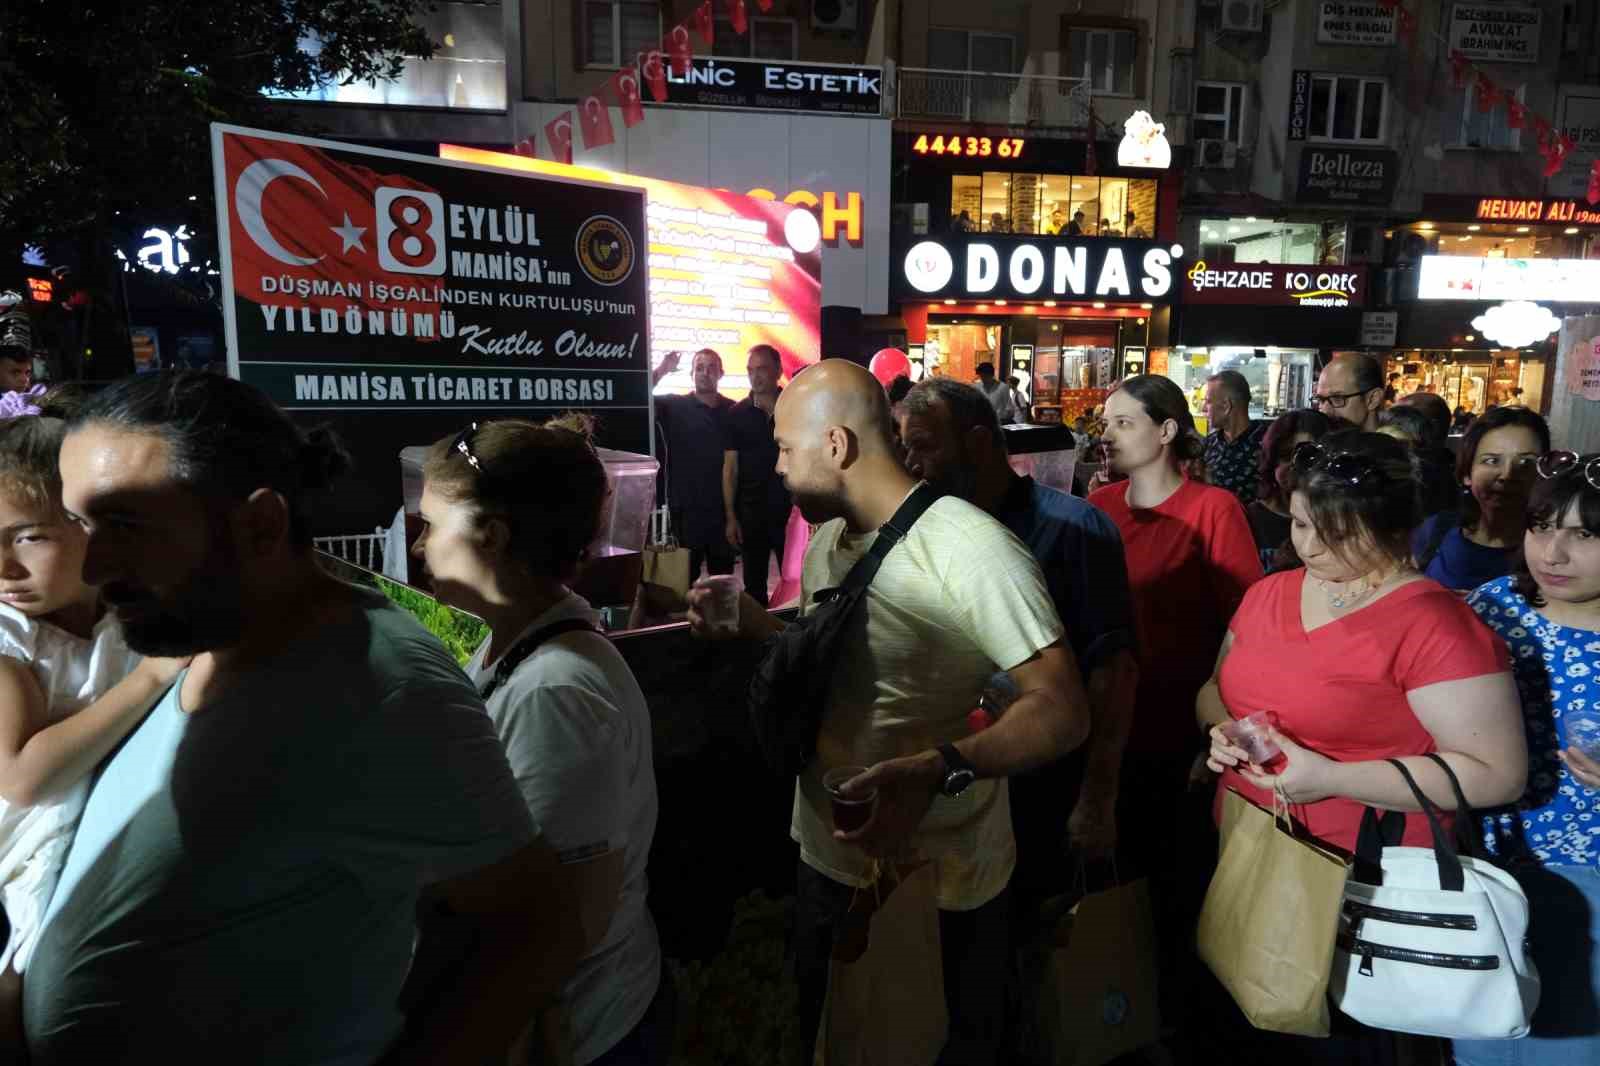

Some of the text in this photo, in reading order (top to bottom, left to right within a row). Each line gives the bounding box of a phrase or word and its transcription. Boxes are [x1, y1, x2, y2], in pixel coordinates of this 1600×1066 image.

[660, 60, 881, 95] LİNİC ESTETİK
[913, 134, 1025, 158] 444 33 67
[1310, 151, 1385, 178] Belleza
[1478, 199, 1543, 219] HELVACI
[387, 195, 541, 266] 8 EYLÜL
[966, 243, 1172, 297] DONAS
[1192, 270, 1358, 294] ŞEHZADE KOOREÇ
[261, 275, 361, 298] DÜŞMAN
[369, 280, 493, 307] İŞGALİNDEN
[261, 304, 457, 339] YILDÖNÜMÜ
[459, 325, 544, 357] Kutlu
[554, 330, 639, 359] Olsun!
[295, 370, 614, 401] MANİSA TİCARET BORSASI
